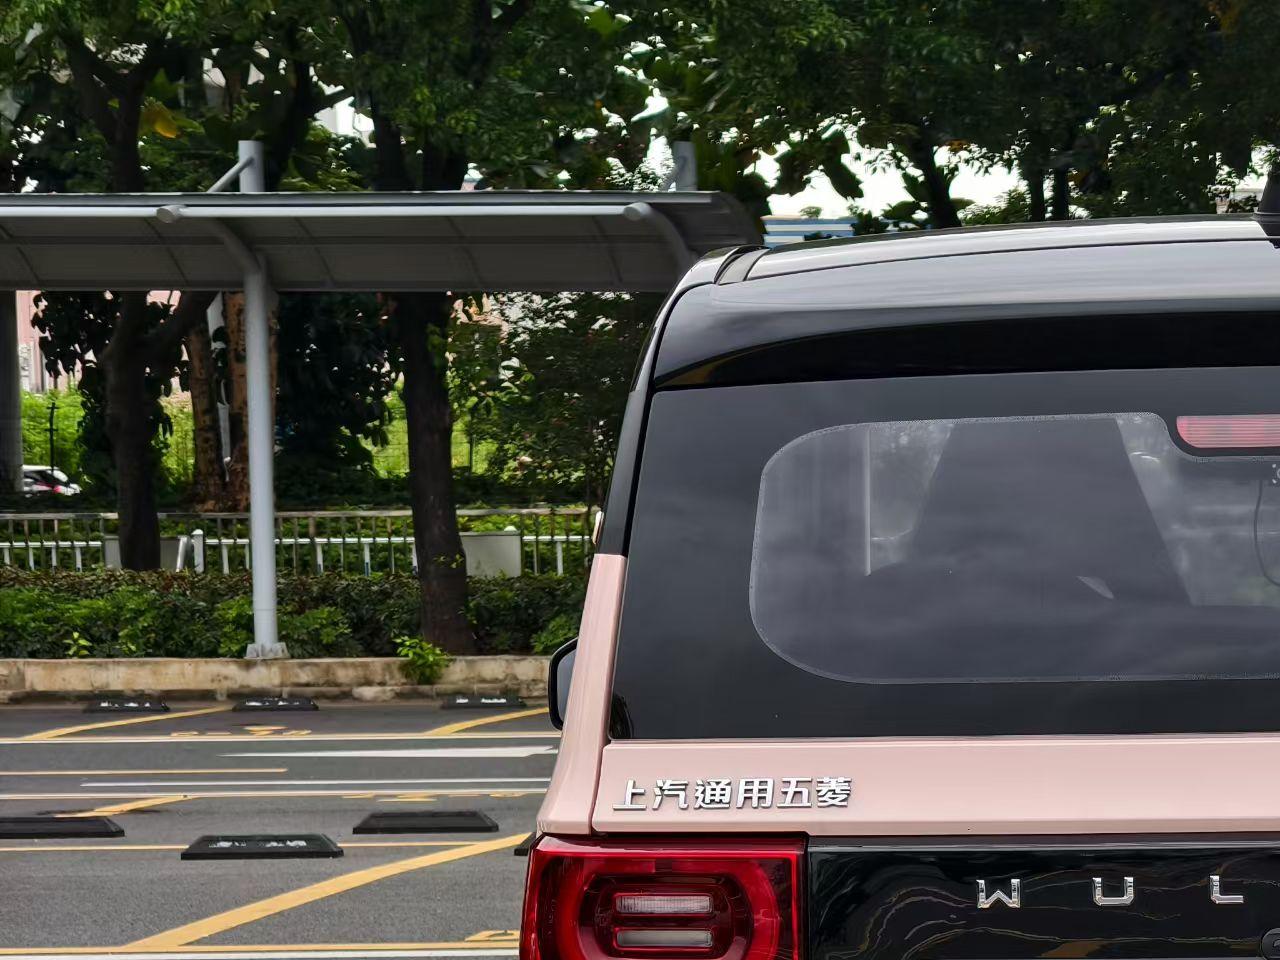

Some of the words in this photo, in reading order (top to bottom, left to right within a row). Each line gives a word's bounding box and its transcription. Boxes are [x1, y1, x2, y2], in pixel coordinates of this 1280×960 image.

[612, 776, 852, 811] 上汽通用五菱
